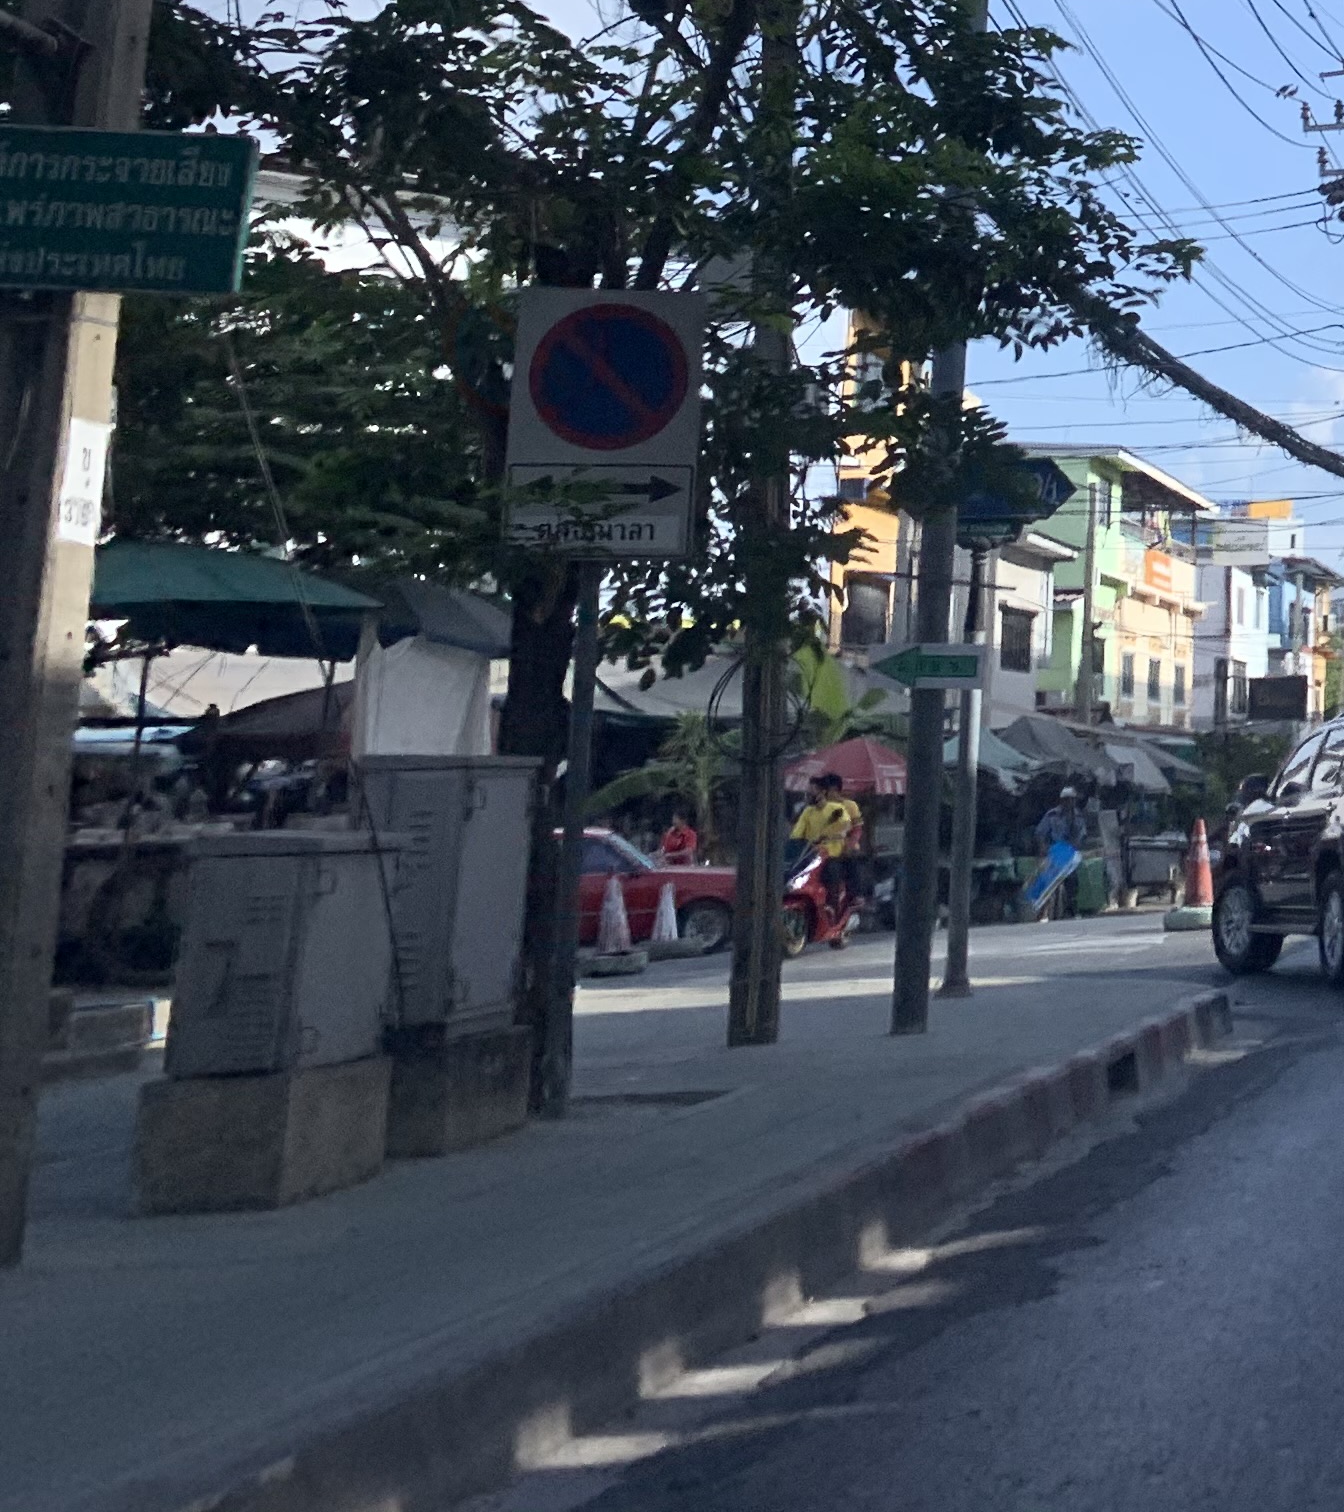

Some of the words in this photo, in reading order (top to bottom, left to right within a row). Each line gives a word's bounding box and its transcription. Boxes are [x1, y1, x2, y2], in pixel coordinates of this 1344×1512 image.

[0, 193, 236, 236] พร่ภาพสาธารณะ
